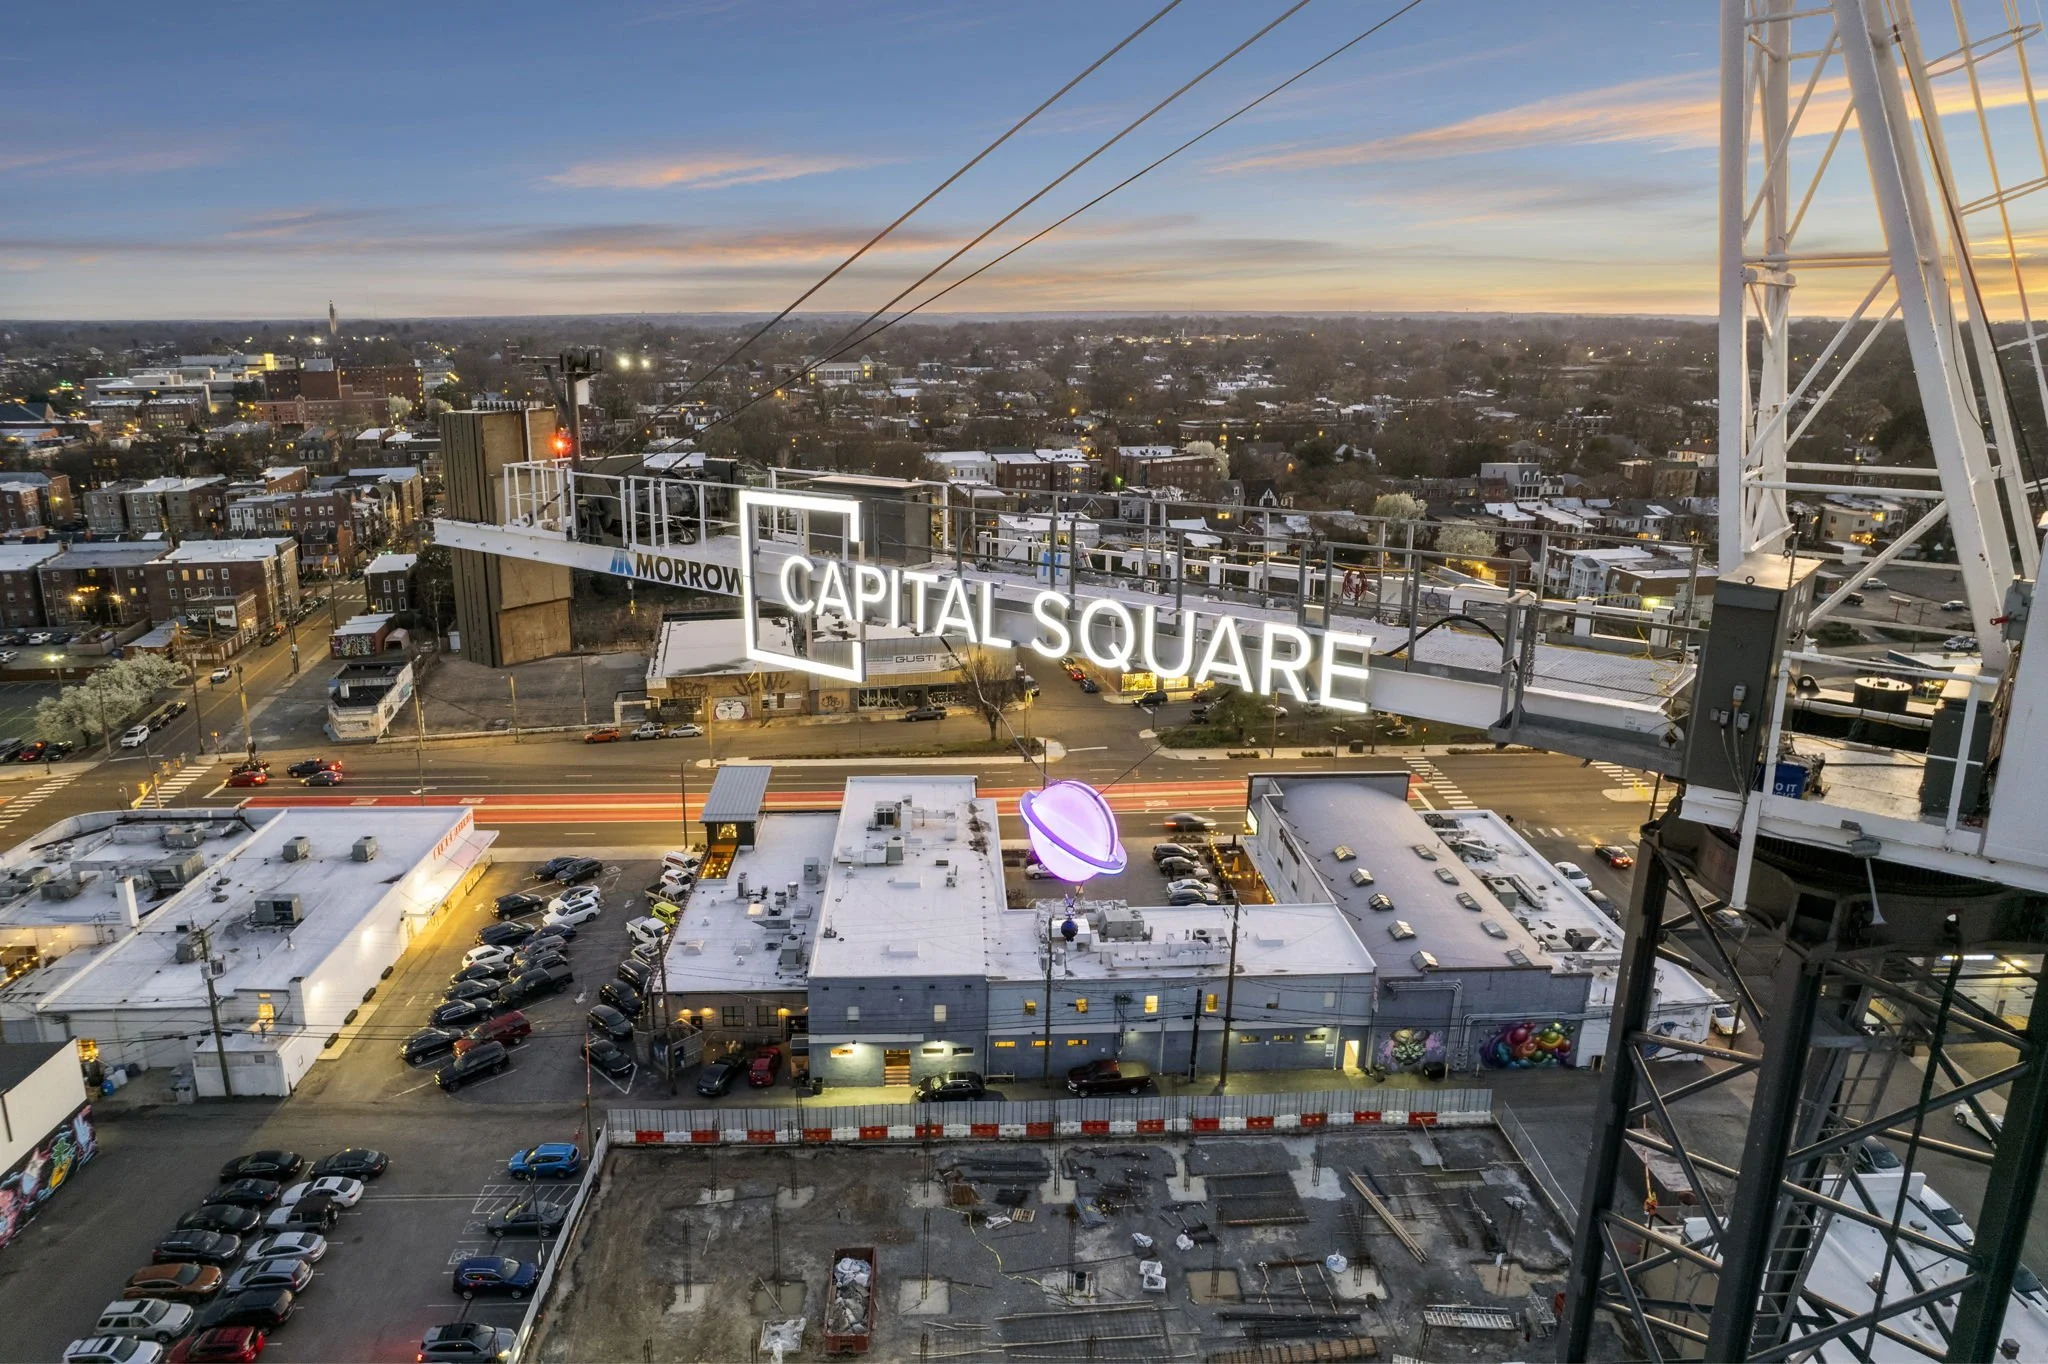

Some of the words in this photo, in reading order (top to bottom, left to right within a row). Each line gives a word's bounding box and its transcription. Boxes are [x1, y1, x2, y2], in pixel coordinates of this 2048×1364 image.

[636, 552, 744, 595] MORROW
[779, 554, 1014, 650] CAPITAL
[1030, 589, 1373, 714] SQUARE
[895, 654, 937, 664] GUSTI
[1786, 783, 1798, 793] IT
